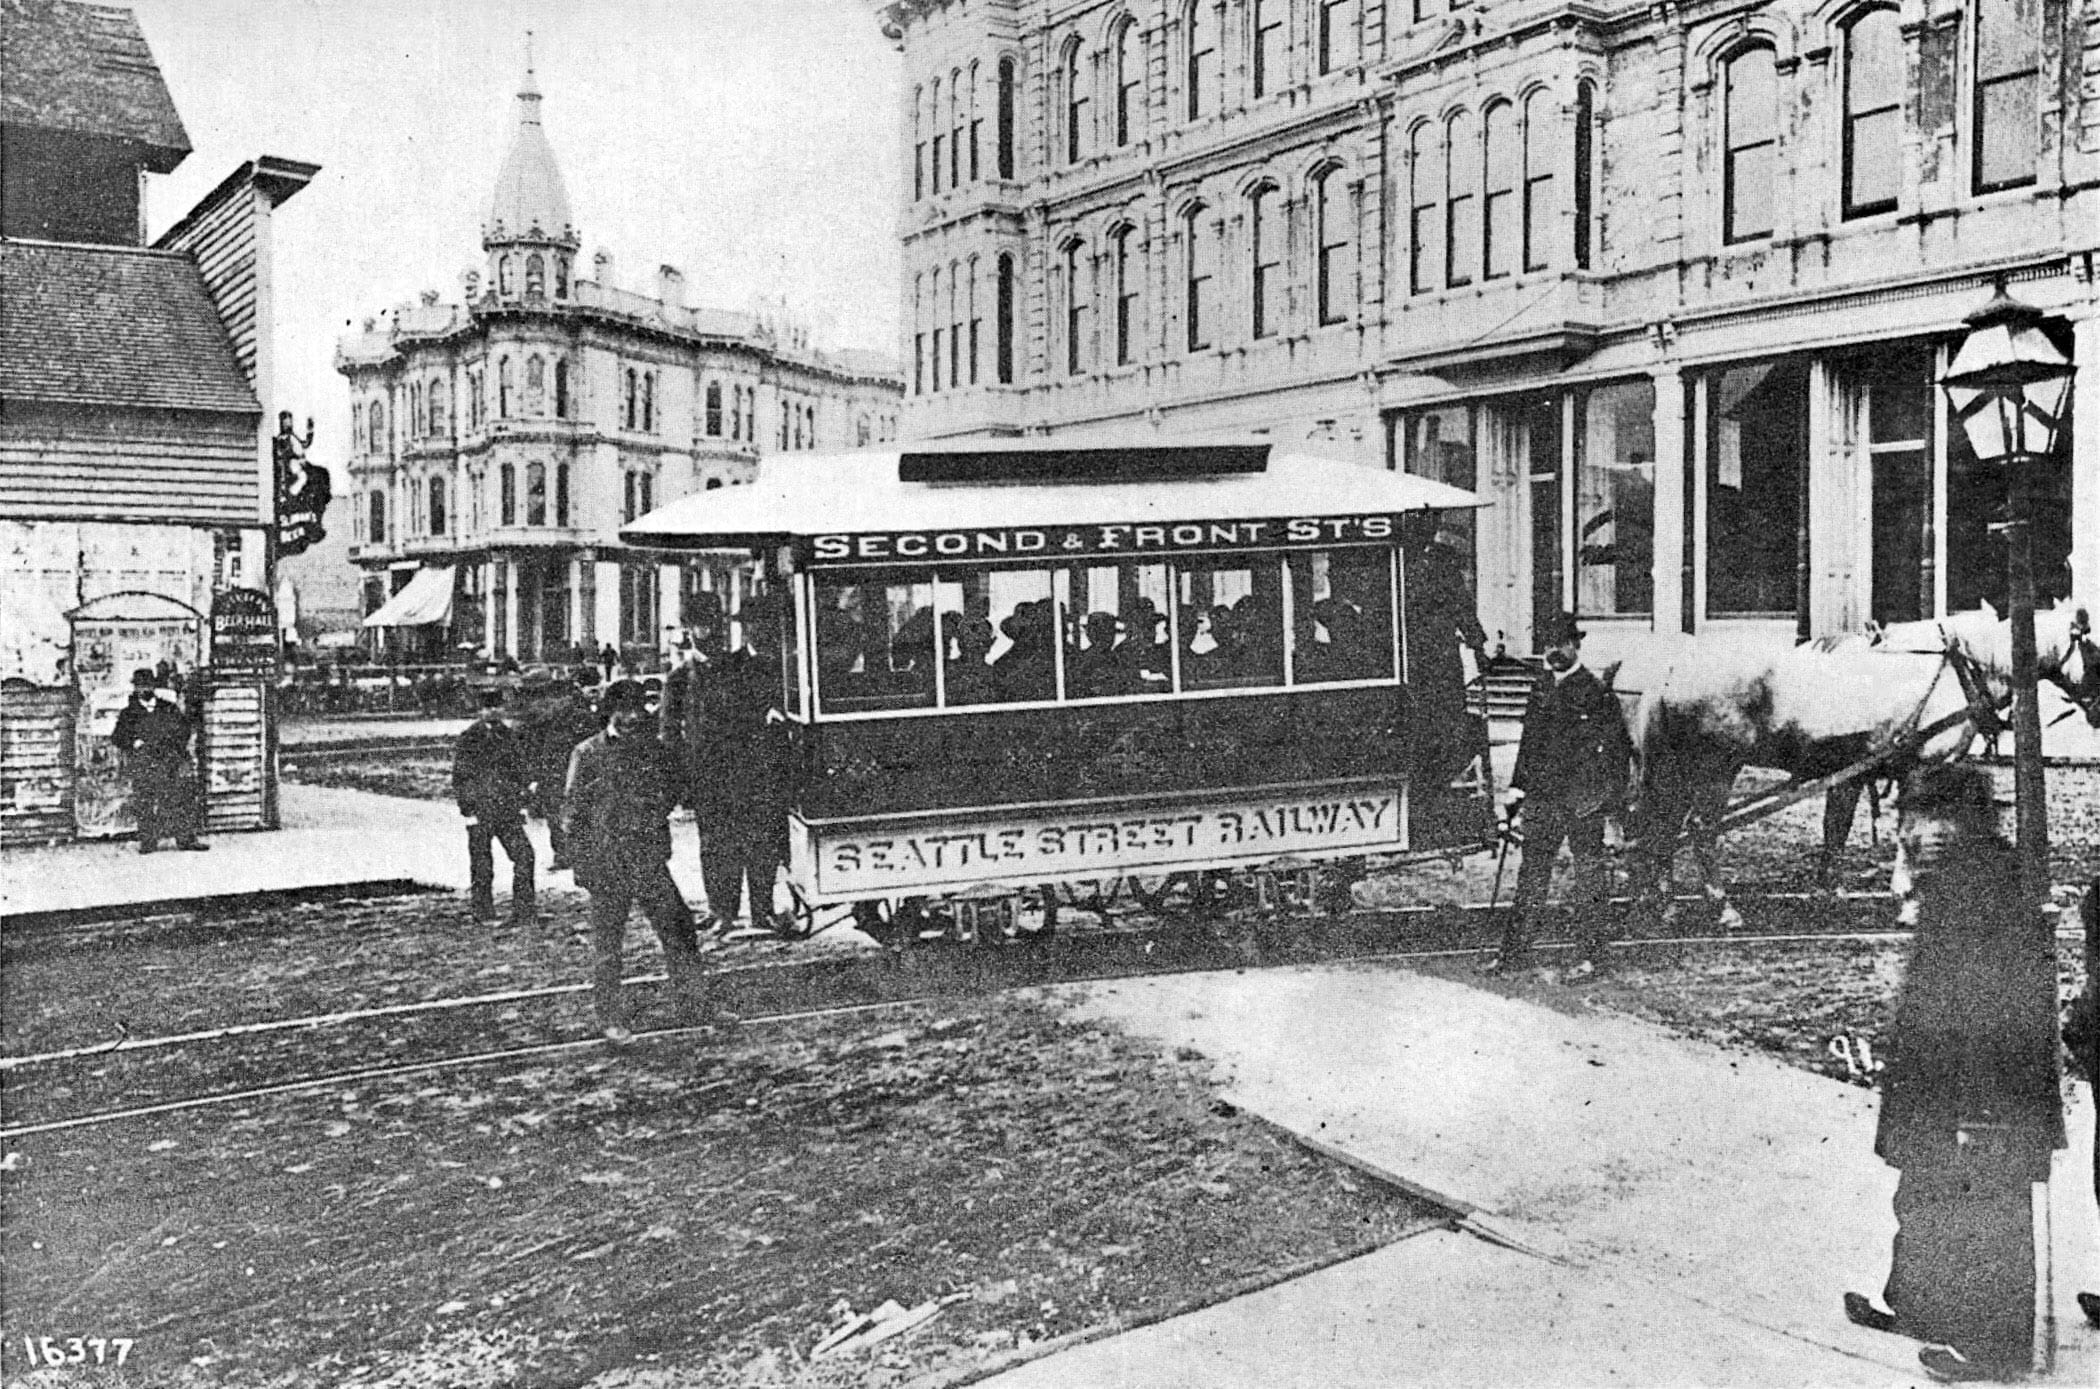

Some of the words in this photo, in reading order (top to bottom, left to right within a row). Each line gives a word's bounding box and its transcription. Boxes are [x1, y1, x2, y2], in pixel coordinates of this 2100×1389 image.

[813, 531, 1045, 559] SECOND
[1062, 532, 1083, 549] &
[1098, 523, 1267, 548] FRONT
[1287, 517, 1392, 541] ST'S
[834, 829, 1025, 871] SEATTLE
[1037, 815, 1203, 854] STREET
[1216, 798, 1392, 843] RAILWAY
